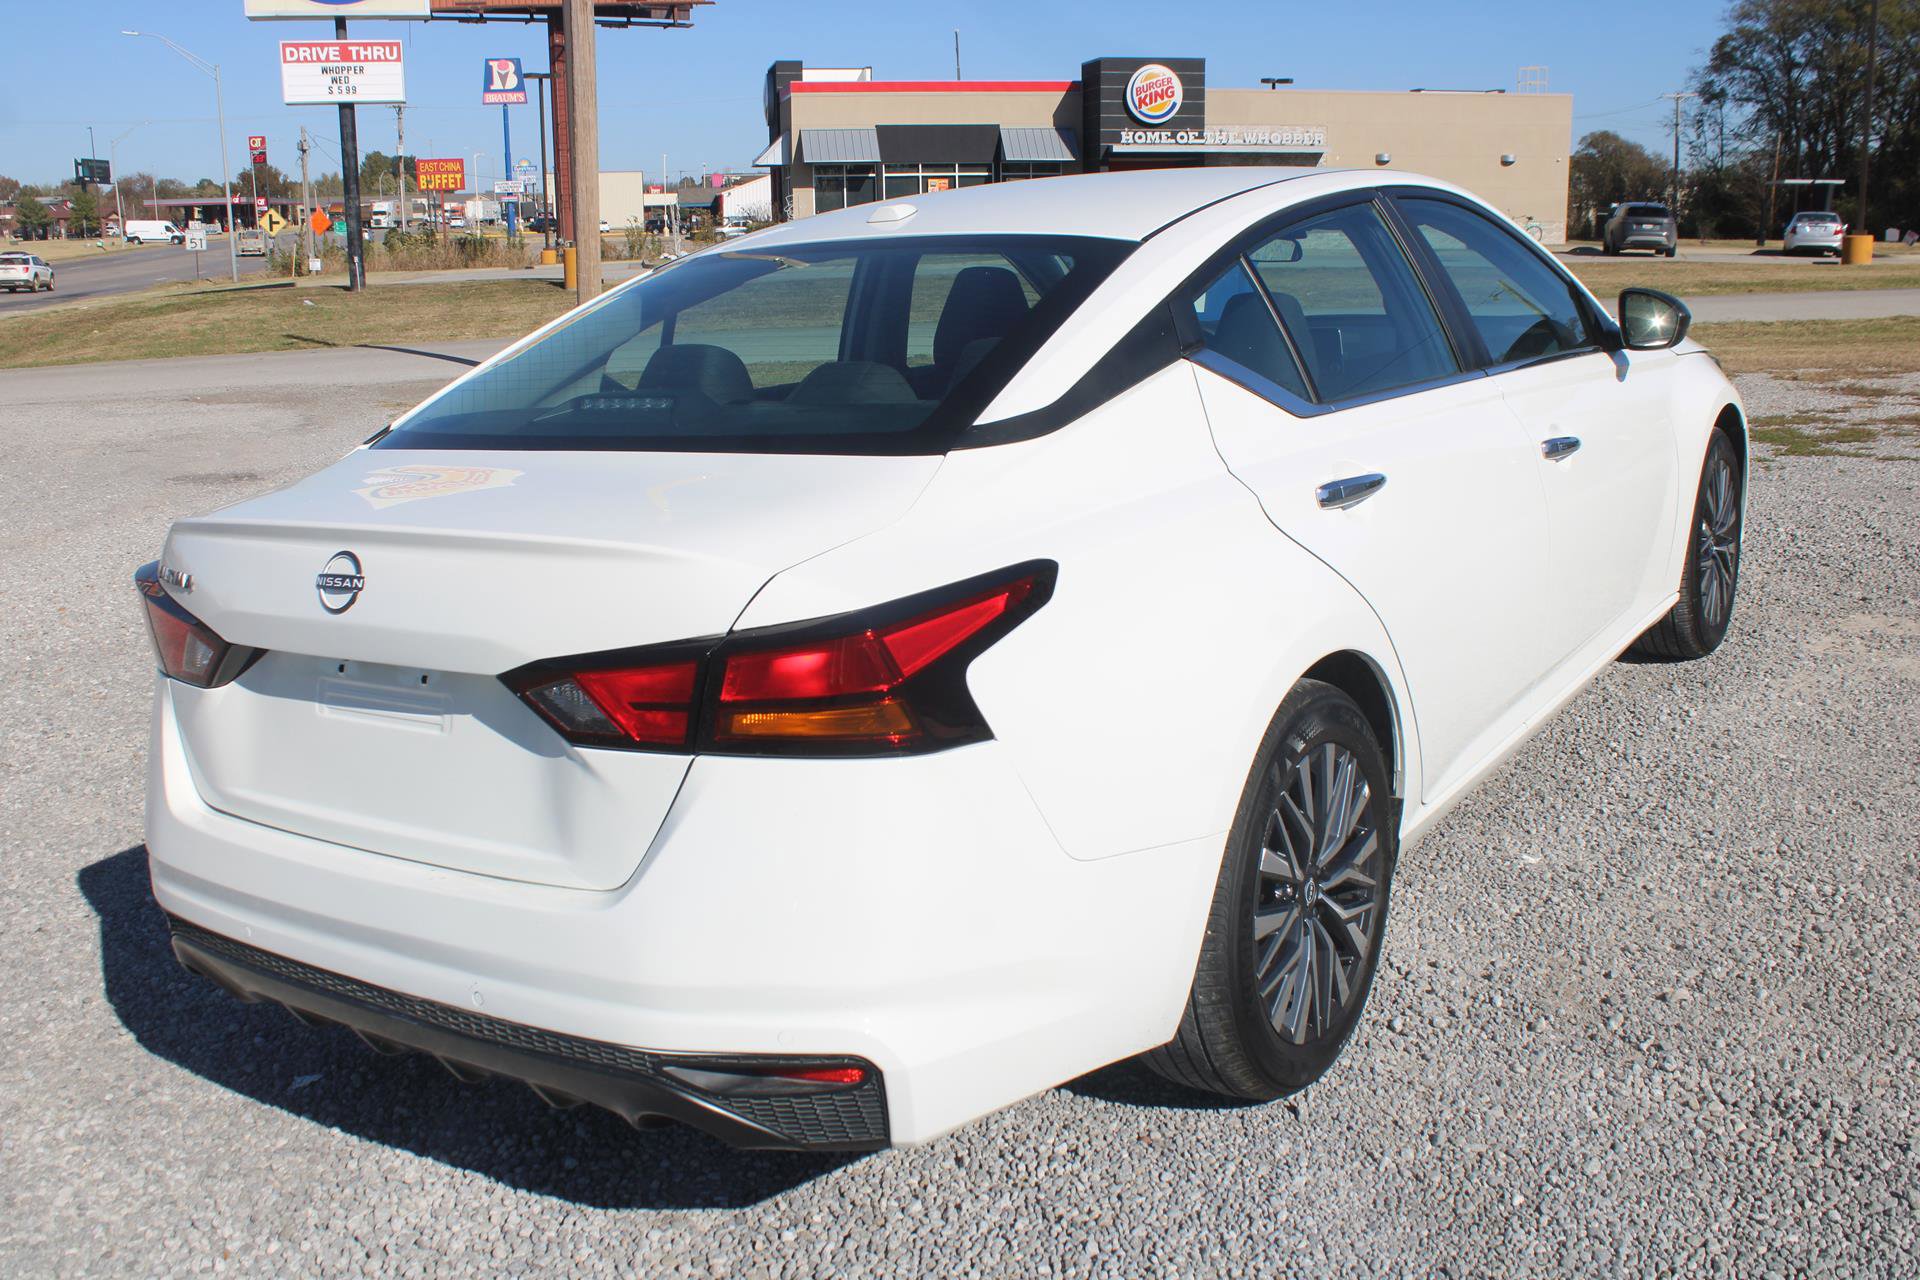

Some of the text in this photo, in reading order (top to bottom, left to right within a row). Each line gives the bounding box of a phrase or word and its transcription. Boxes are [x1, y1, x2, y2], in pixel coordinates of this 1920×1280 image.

[285, 45, 398, 62] DRIVE THRU
[321, 65, 365, 75] WHOPPER
[331, 75, 350, 85] WED
[1135, 77, 1173, 97] BURGER
[486, 93, 525, 102] BRAUM'S
[1137, 86, 1176, 111] KING
[250, 138, 262, 148] QT
[1120, 131, 1176, 145] HOME
[1176, 131, 1204, 145] OF
[1204, 131, 1240, 145] THE
[420, 161, 461, 172] EAST CHINA
[420, 173, 462, 190] BUFFET
[189, 238, 203, 249] 51
[317, 577, 363, 588] NISSAN
